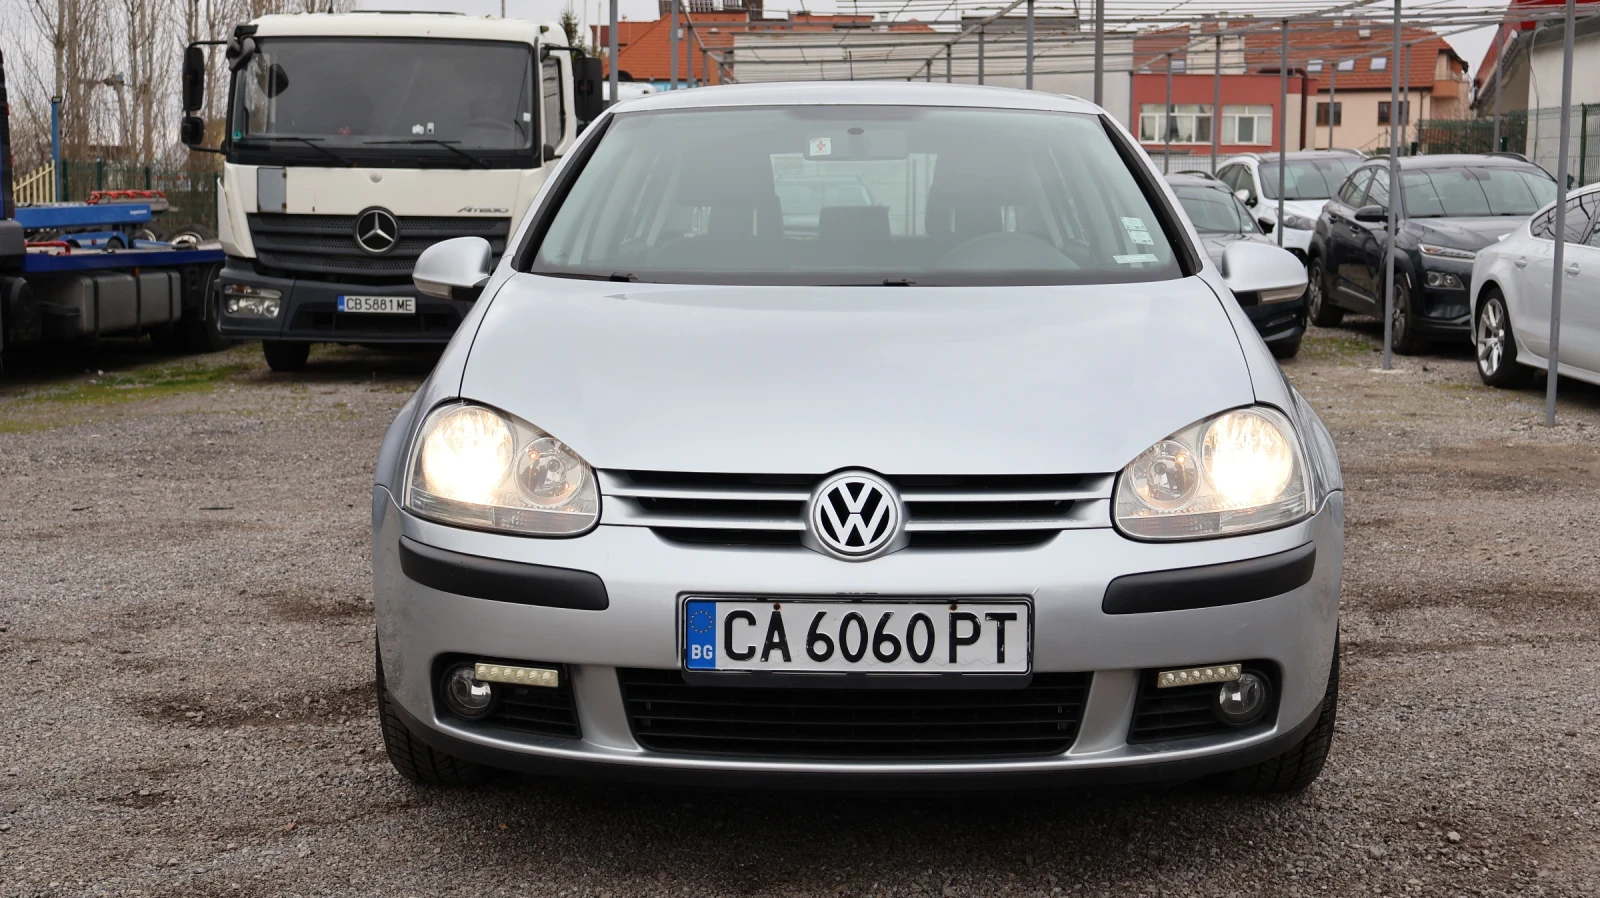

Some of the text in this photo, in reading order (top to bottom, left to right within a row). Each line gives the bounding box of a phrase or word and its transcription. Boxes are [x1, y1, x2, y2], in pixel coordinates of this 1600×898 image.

[346, 298, 413, 312] CB 5881 ME
[816, 476, 895, 552] VW
[691, 644, 713, 660] BG
[724, 610, 1018, 664] CA 6060 PT
